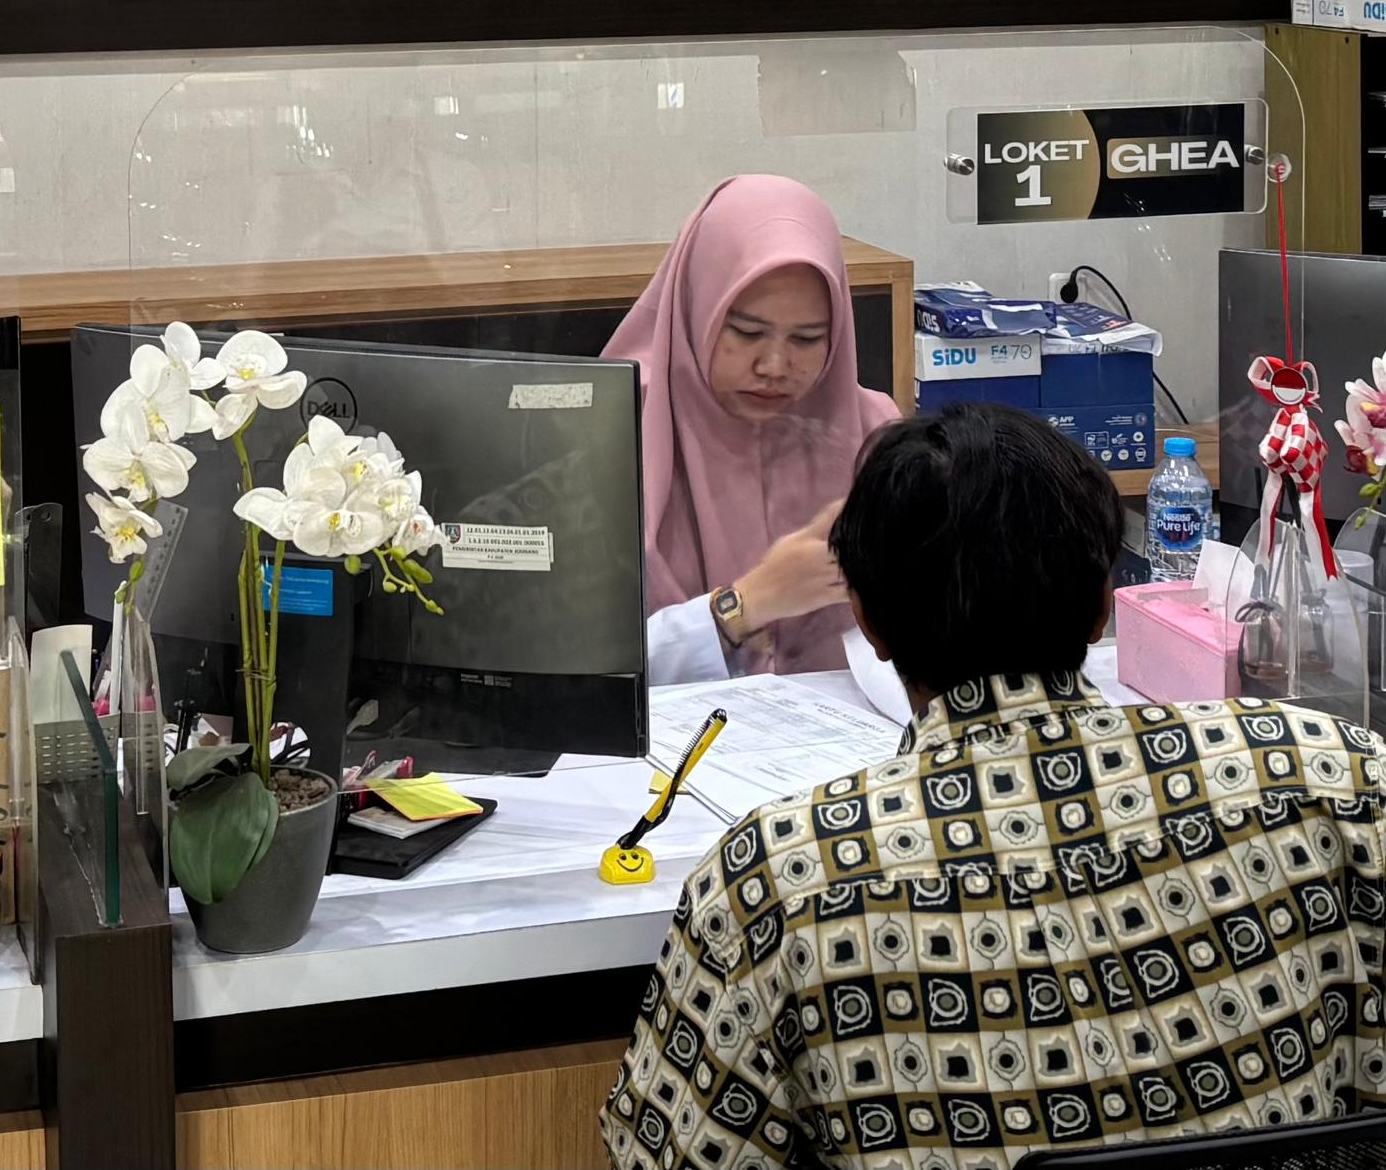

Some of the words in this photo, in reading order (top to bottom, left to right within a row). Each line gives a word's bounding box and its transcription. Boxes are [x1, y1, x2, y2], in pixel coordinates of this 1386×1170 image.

[984, 139, 1090, 164] LOKET
[1111, 140, 1240, 173] GHEA
[1014, 165, 1052, 207] 1
[932, 348, 977, 366] SiDU
[991, 345, 1008, 355] F4
[308, 400, 351, 419] DELL
[1157, 520, 1181, 532] Pure
[1182, 521, 1201, 535] Life
